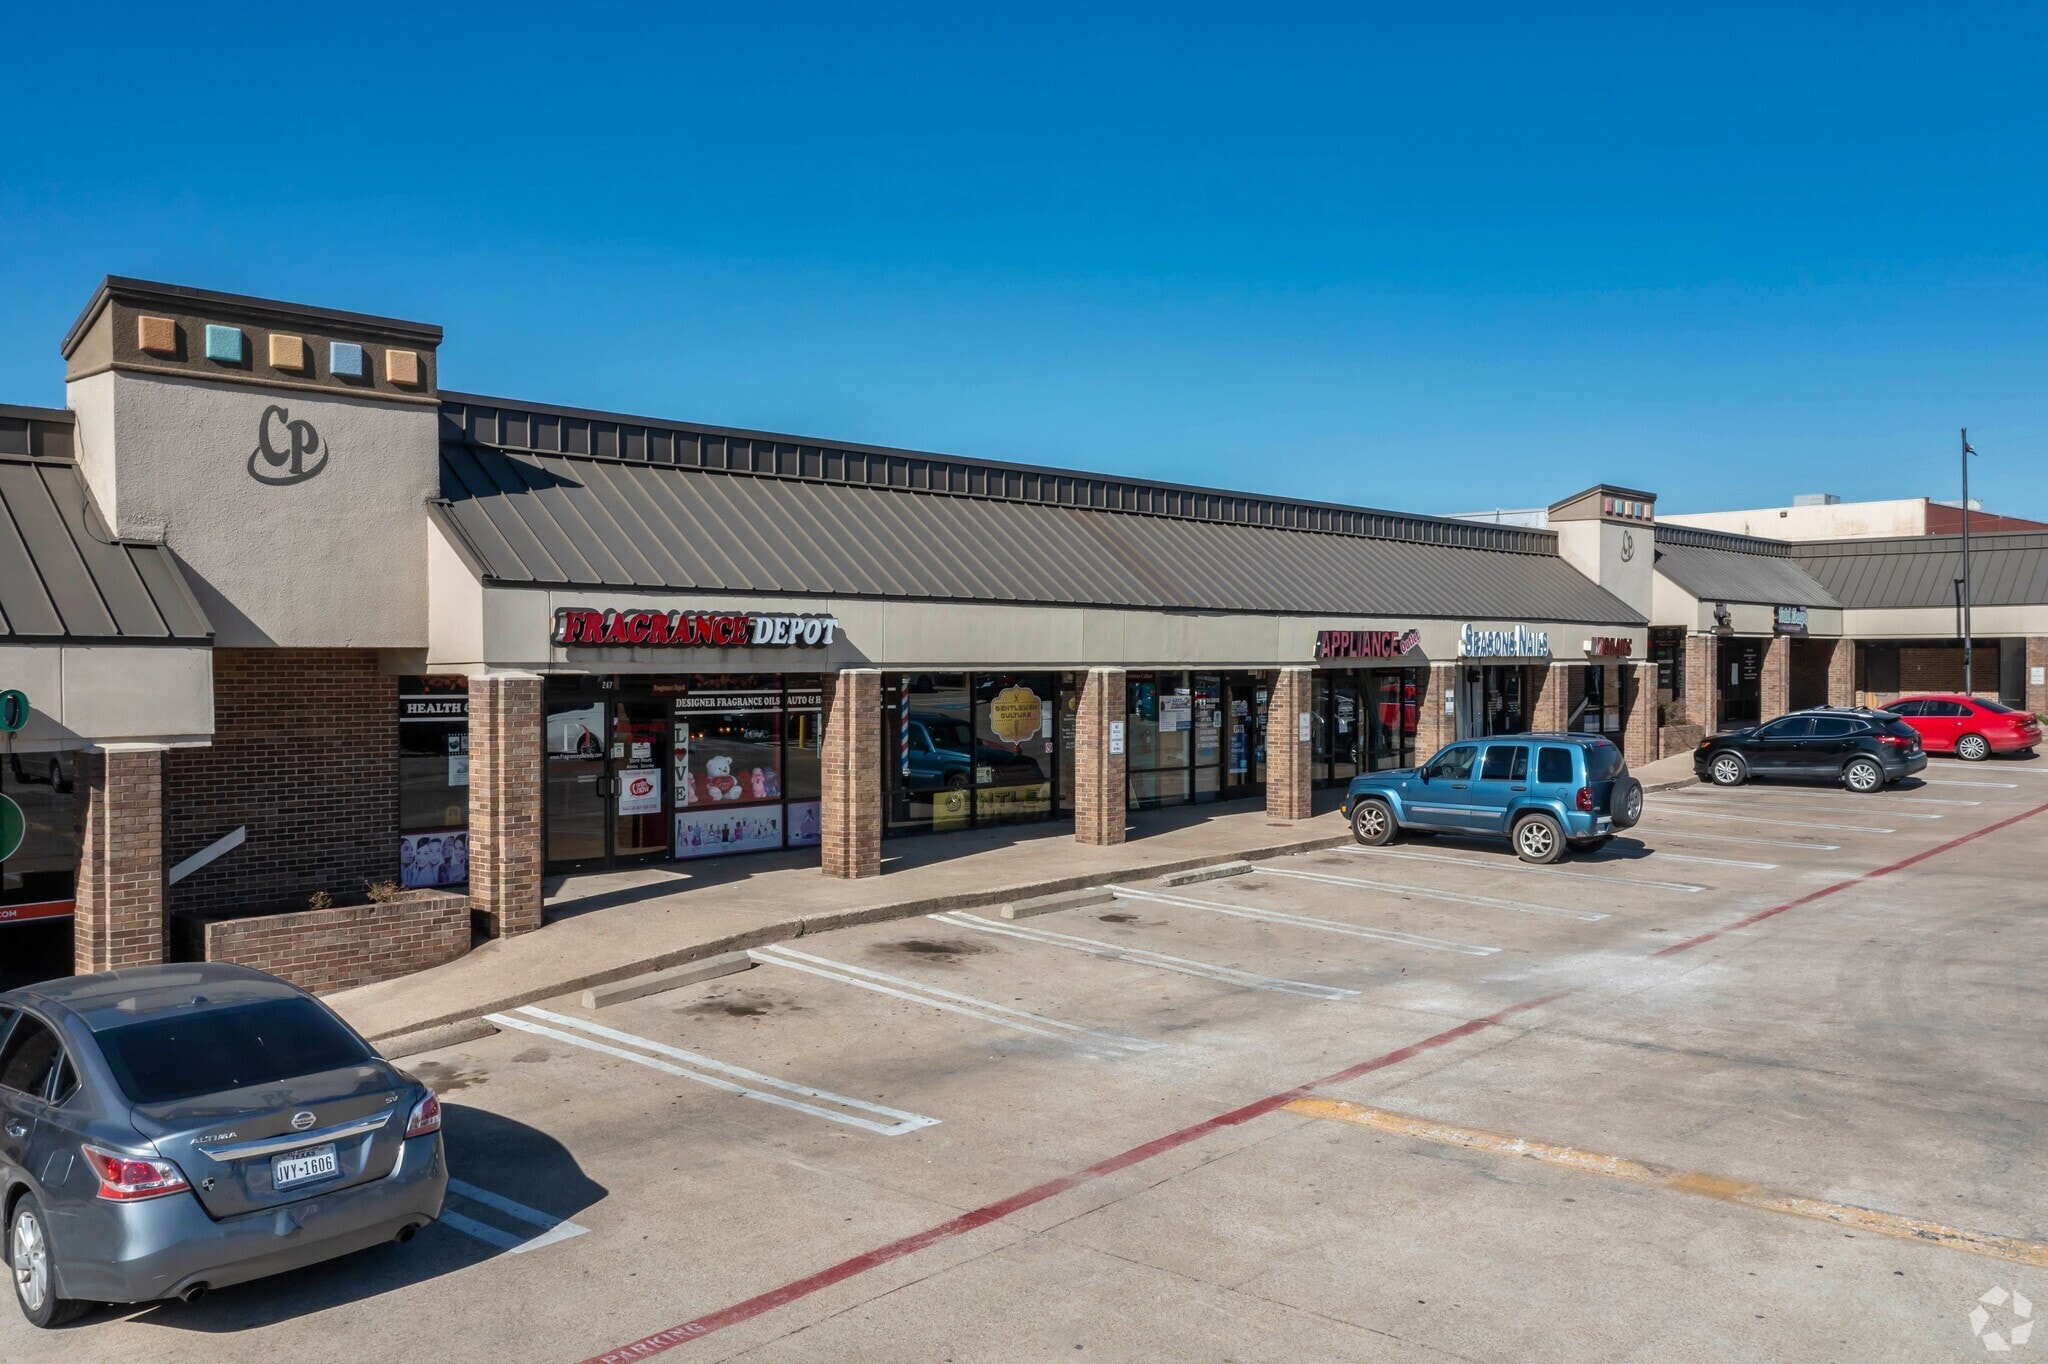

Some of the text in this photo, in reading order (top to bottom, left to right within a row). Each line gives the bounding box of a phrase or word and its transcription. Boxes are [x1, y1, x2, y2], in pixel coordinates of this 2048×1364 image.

[562, 611, 839, 645] FRAGRANCE DEPOT
[1322, 631, 1399, 658] APPLIANCE
[1464, 624, 1549, 657] SEASONS NAILS
[602, 681, 613, 690] 247
[675, 696, 781, 709] DESIGNER FRAGRANCE OILS
[787, 696, 807, 705] AUTO
[807, 696, 816, 705] &
[406, 703, 462, 714] HEALTH
[995, 704, 1038, 712] GENTLEMEN
[190, 1131, 238, 1146] ALTIMA
[292, 1150, 316, 1161] TEXAS
[600, 1322, 706, 1364] PARKING
